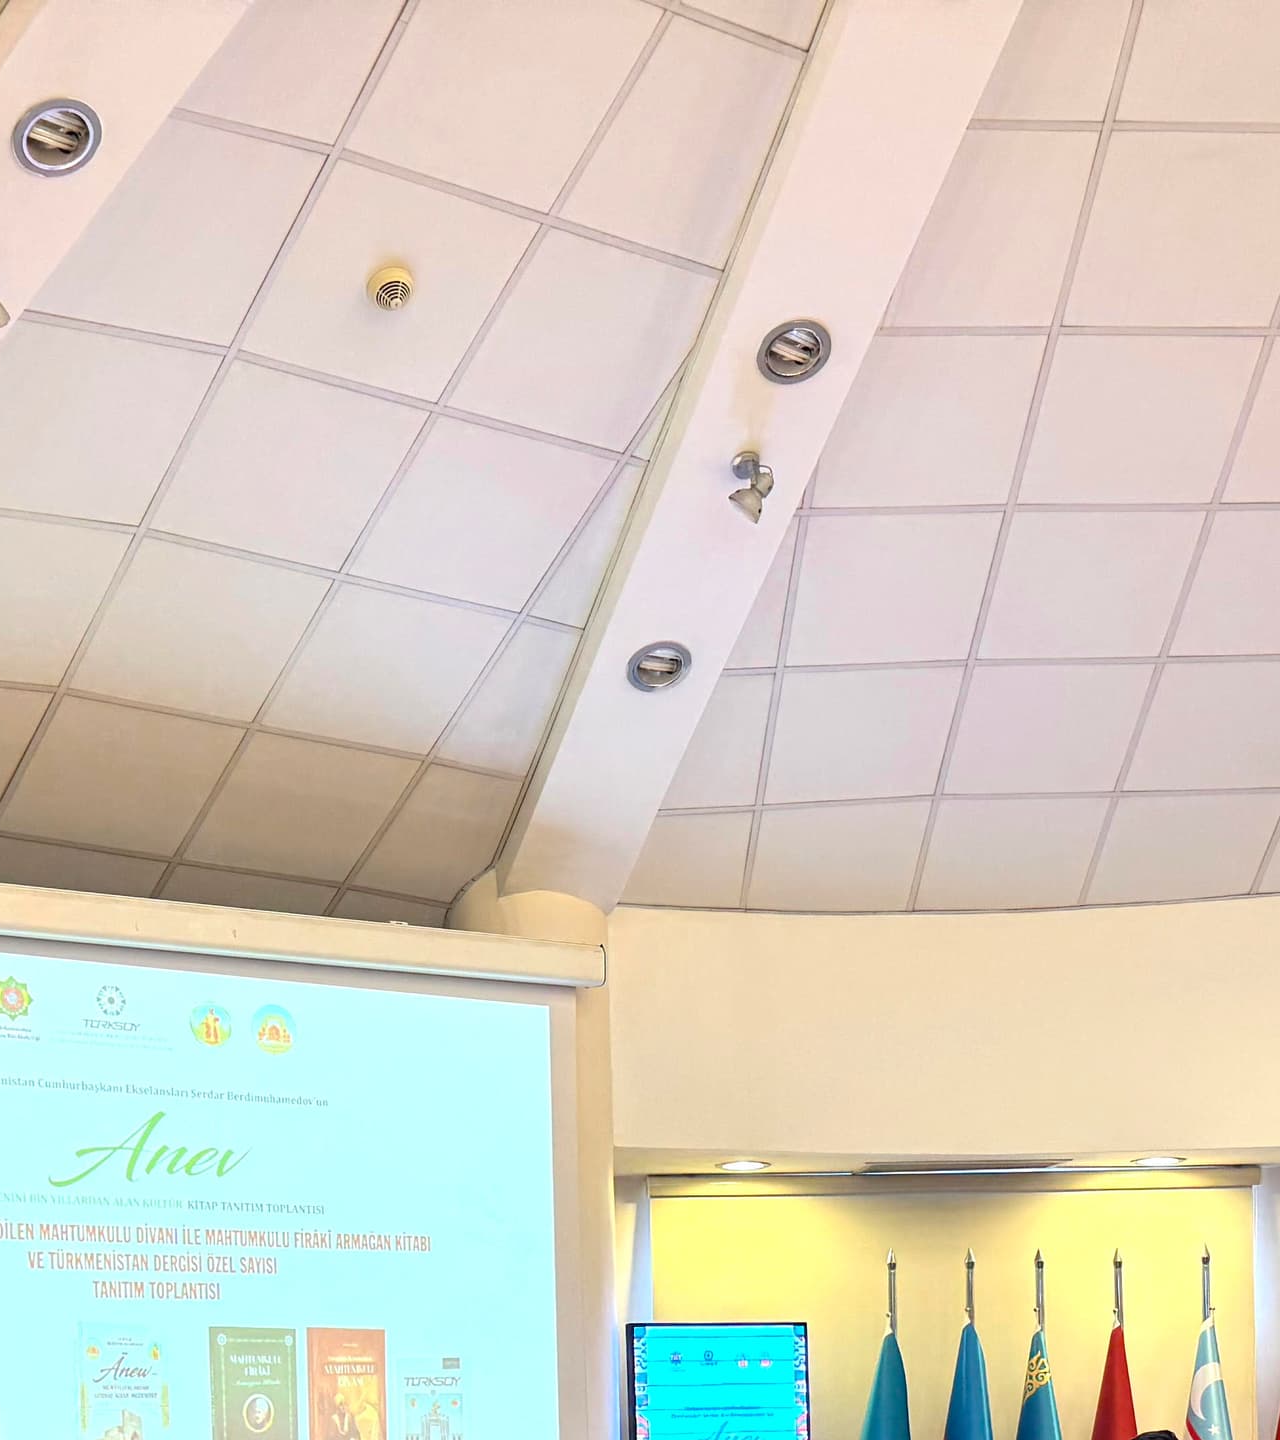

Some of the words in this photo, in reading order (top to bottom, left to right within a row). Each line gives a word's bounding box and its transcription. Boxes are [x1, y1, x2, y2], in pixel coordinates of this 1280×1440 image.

[191, 1087, 225, 1101] Serdar
[48, 1111, 252, 1187] Anev
[221, 1201, 264, 1213] TANITIM
[266, 1203, 325, 1215] TOPLANTISI
[39, 1223, 132, 1243] MAHTUMKULU
[136, 1223, 178, 1245] DİVANI
[182, 1224, 202, 1246] İLE
[205, 1228, 290, 1248] MAHTUMKULU
[336, 1230, 392, 1251] ARMAĞAN
[395, 1232, 431, 1252] KİTABI
[28, 1251, 45, 1269] VE
[48, 1249, 149, 1272] TÜRKMENİSTAN
[153, 1251, 202, 1273] DERGİSİ
[206, 1253, 237, 1274] ÖZEL
[239, 1256, 278, 1275] SAYISI
[92, 1280, 145, 1299] TANITIM
[149, 1281, 221, 1300] TOPLANTISI
